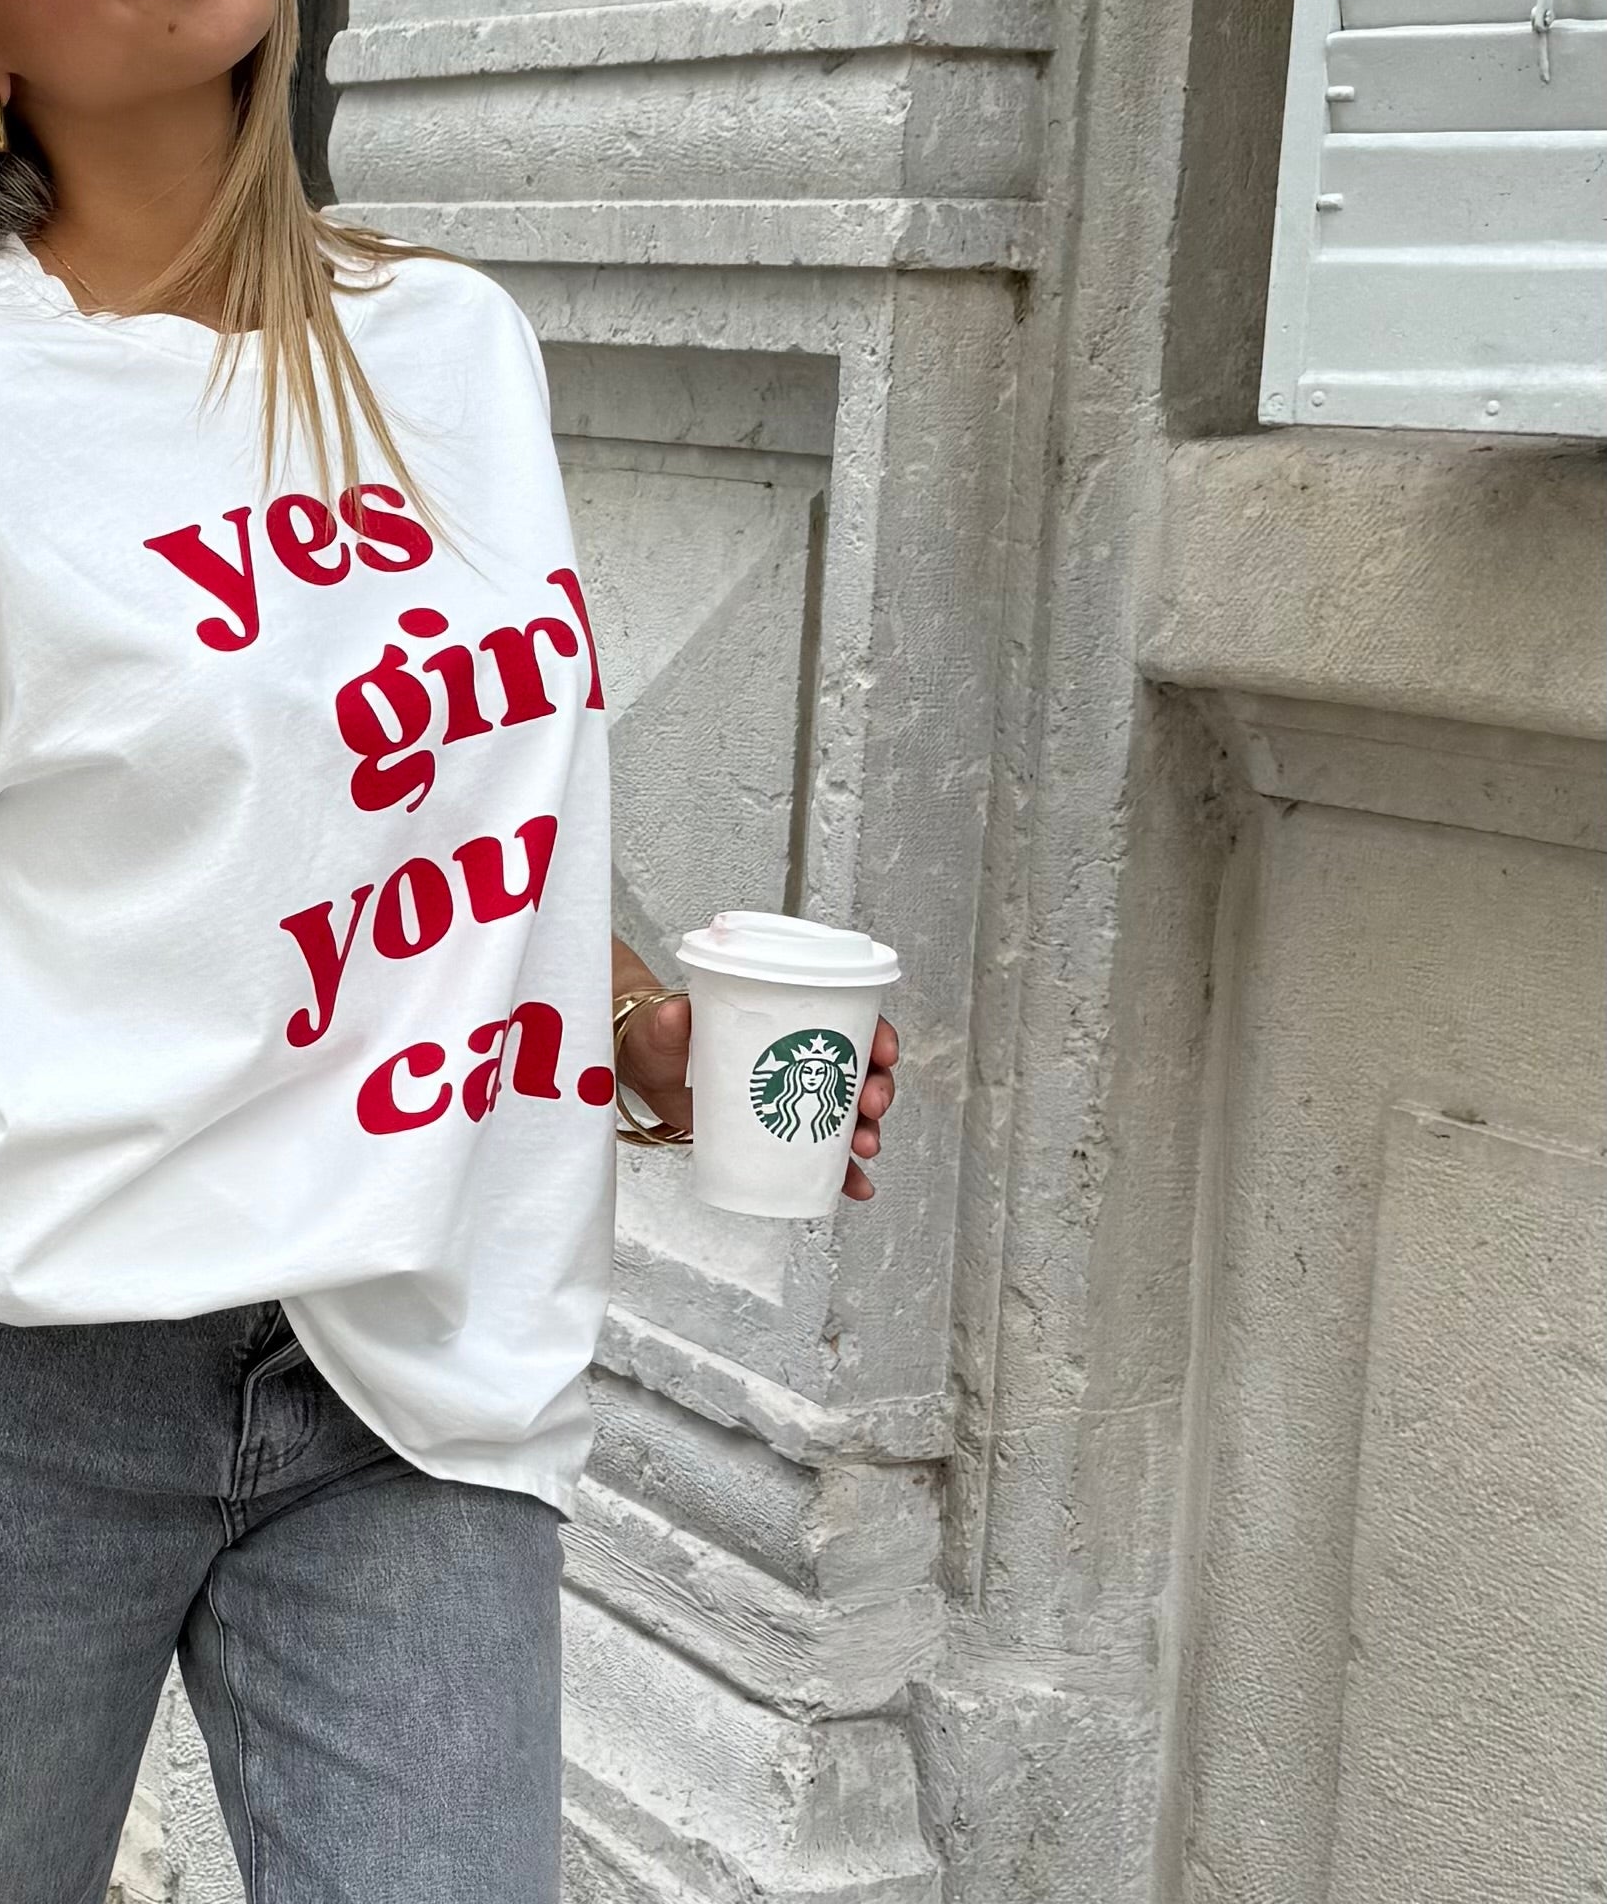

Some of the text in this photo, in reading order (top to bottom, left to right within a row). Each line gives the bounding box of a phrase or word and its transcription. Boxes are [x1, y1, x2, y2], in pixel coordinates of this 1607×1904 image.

[143, 483, 434, 652] yes
[335, 568, 606, 813] girl
[279, 814, 558, 1048] you
[356, 1001, 614, 1135] can.
